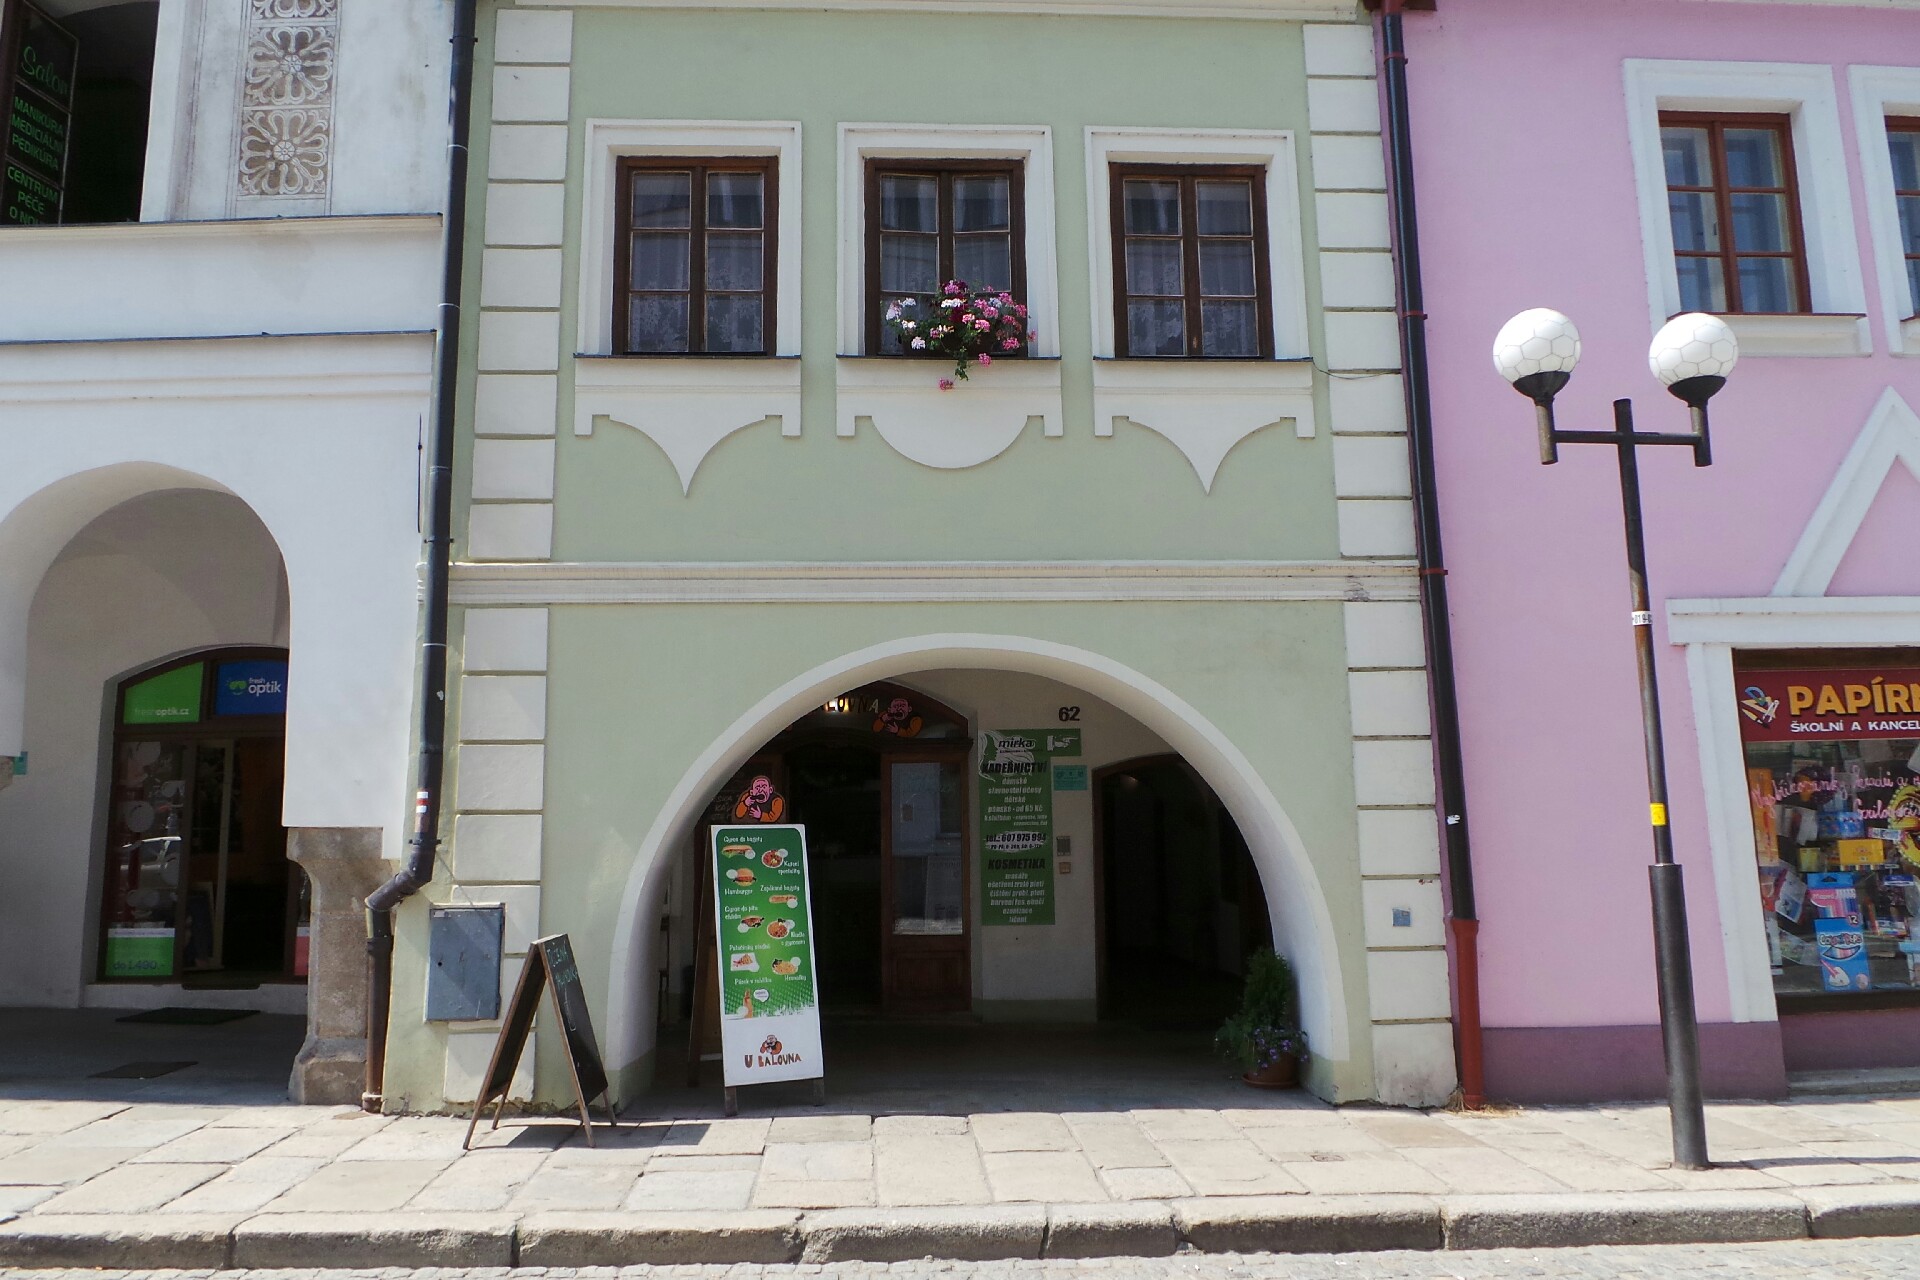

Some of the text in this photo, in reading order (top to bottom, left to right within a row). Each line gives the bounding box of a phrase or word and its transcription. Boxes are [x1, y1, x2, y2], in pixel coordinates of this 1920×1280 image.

[21, 46, 68, 96] Salon
[7, 166, 58, 204] CENTRUM
[248, 681, 281, 696] optik
[1059, 706, 1080, 721] 62
[1790, 720, 1844, 733] ŠKOLNÍ
[1851, 722, 1862, 731] A
[998, 738, 1033, 748] mirka
[1001, 833, 1016, 842] 607
[1016, 833, 1030, 841] 975
[988, 859, 1045, 870] KOSMETIKA
[724, 888, 753, 896] Hamburger
[1847, 915, 1858, 924] 12
[745, 1055, 753, 1068] U
